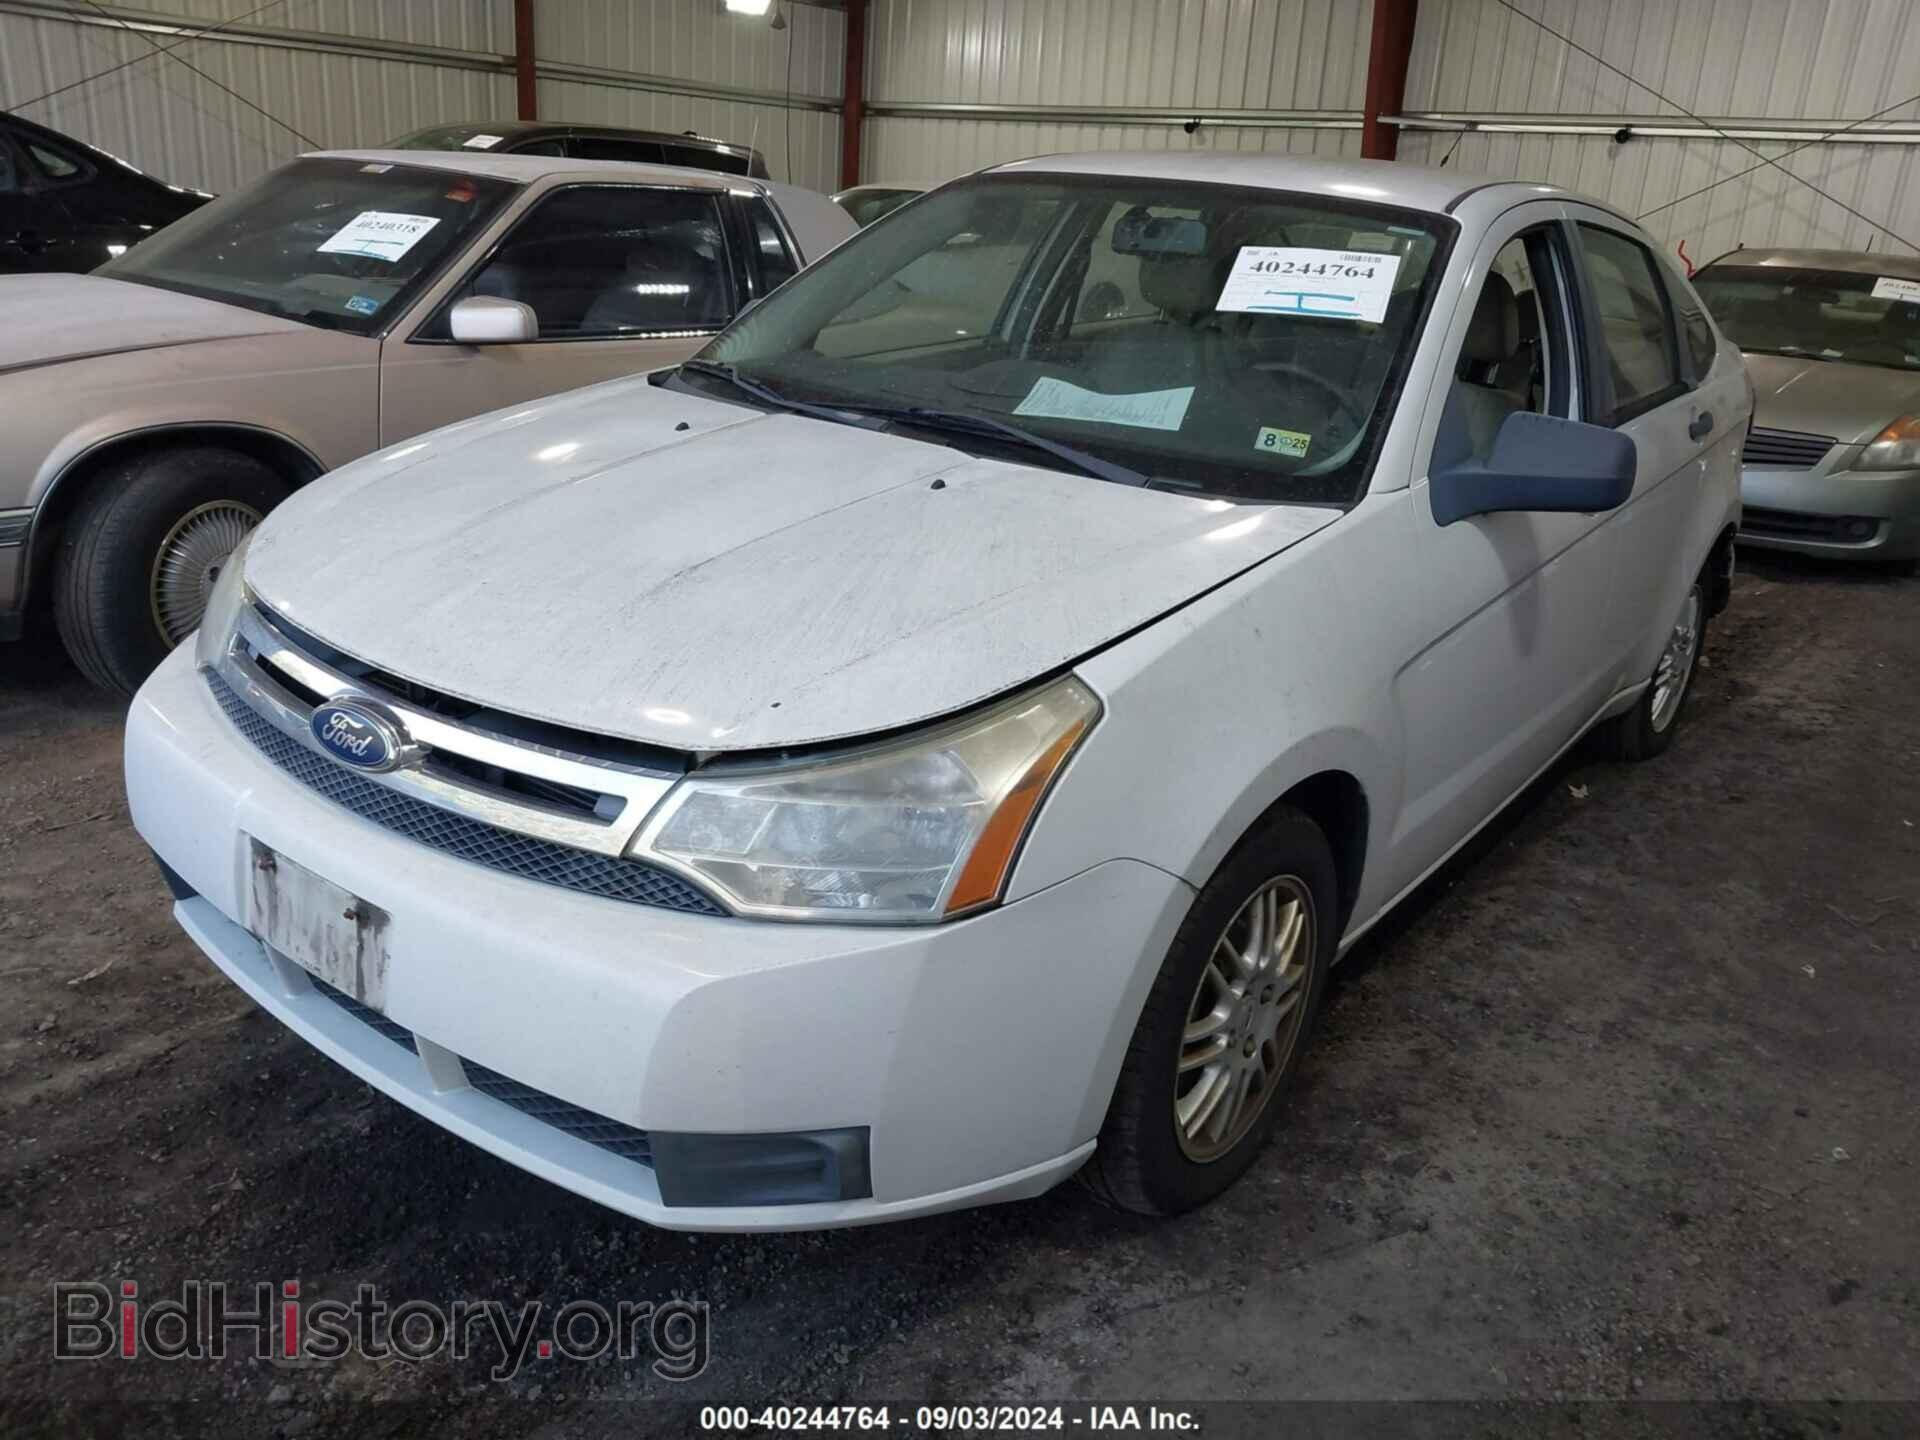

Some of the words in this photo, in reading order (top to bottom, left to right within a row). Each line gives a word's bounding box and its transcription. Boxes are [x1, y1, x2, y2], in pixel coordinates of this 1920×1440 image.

[1249, 260, 1376, 279] 40244764
[1264, 433, 1277, 447] 8
[323, 711, 373, 756] Ford
